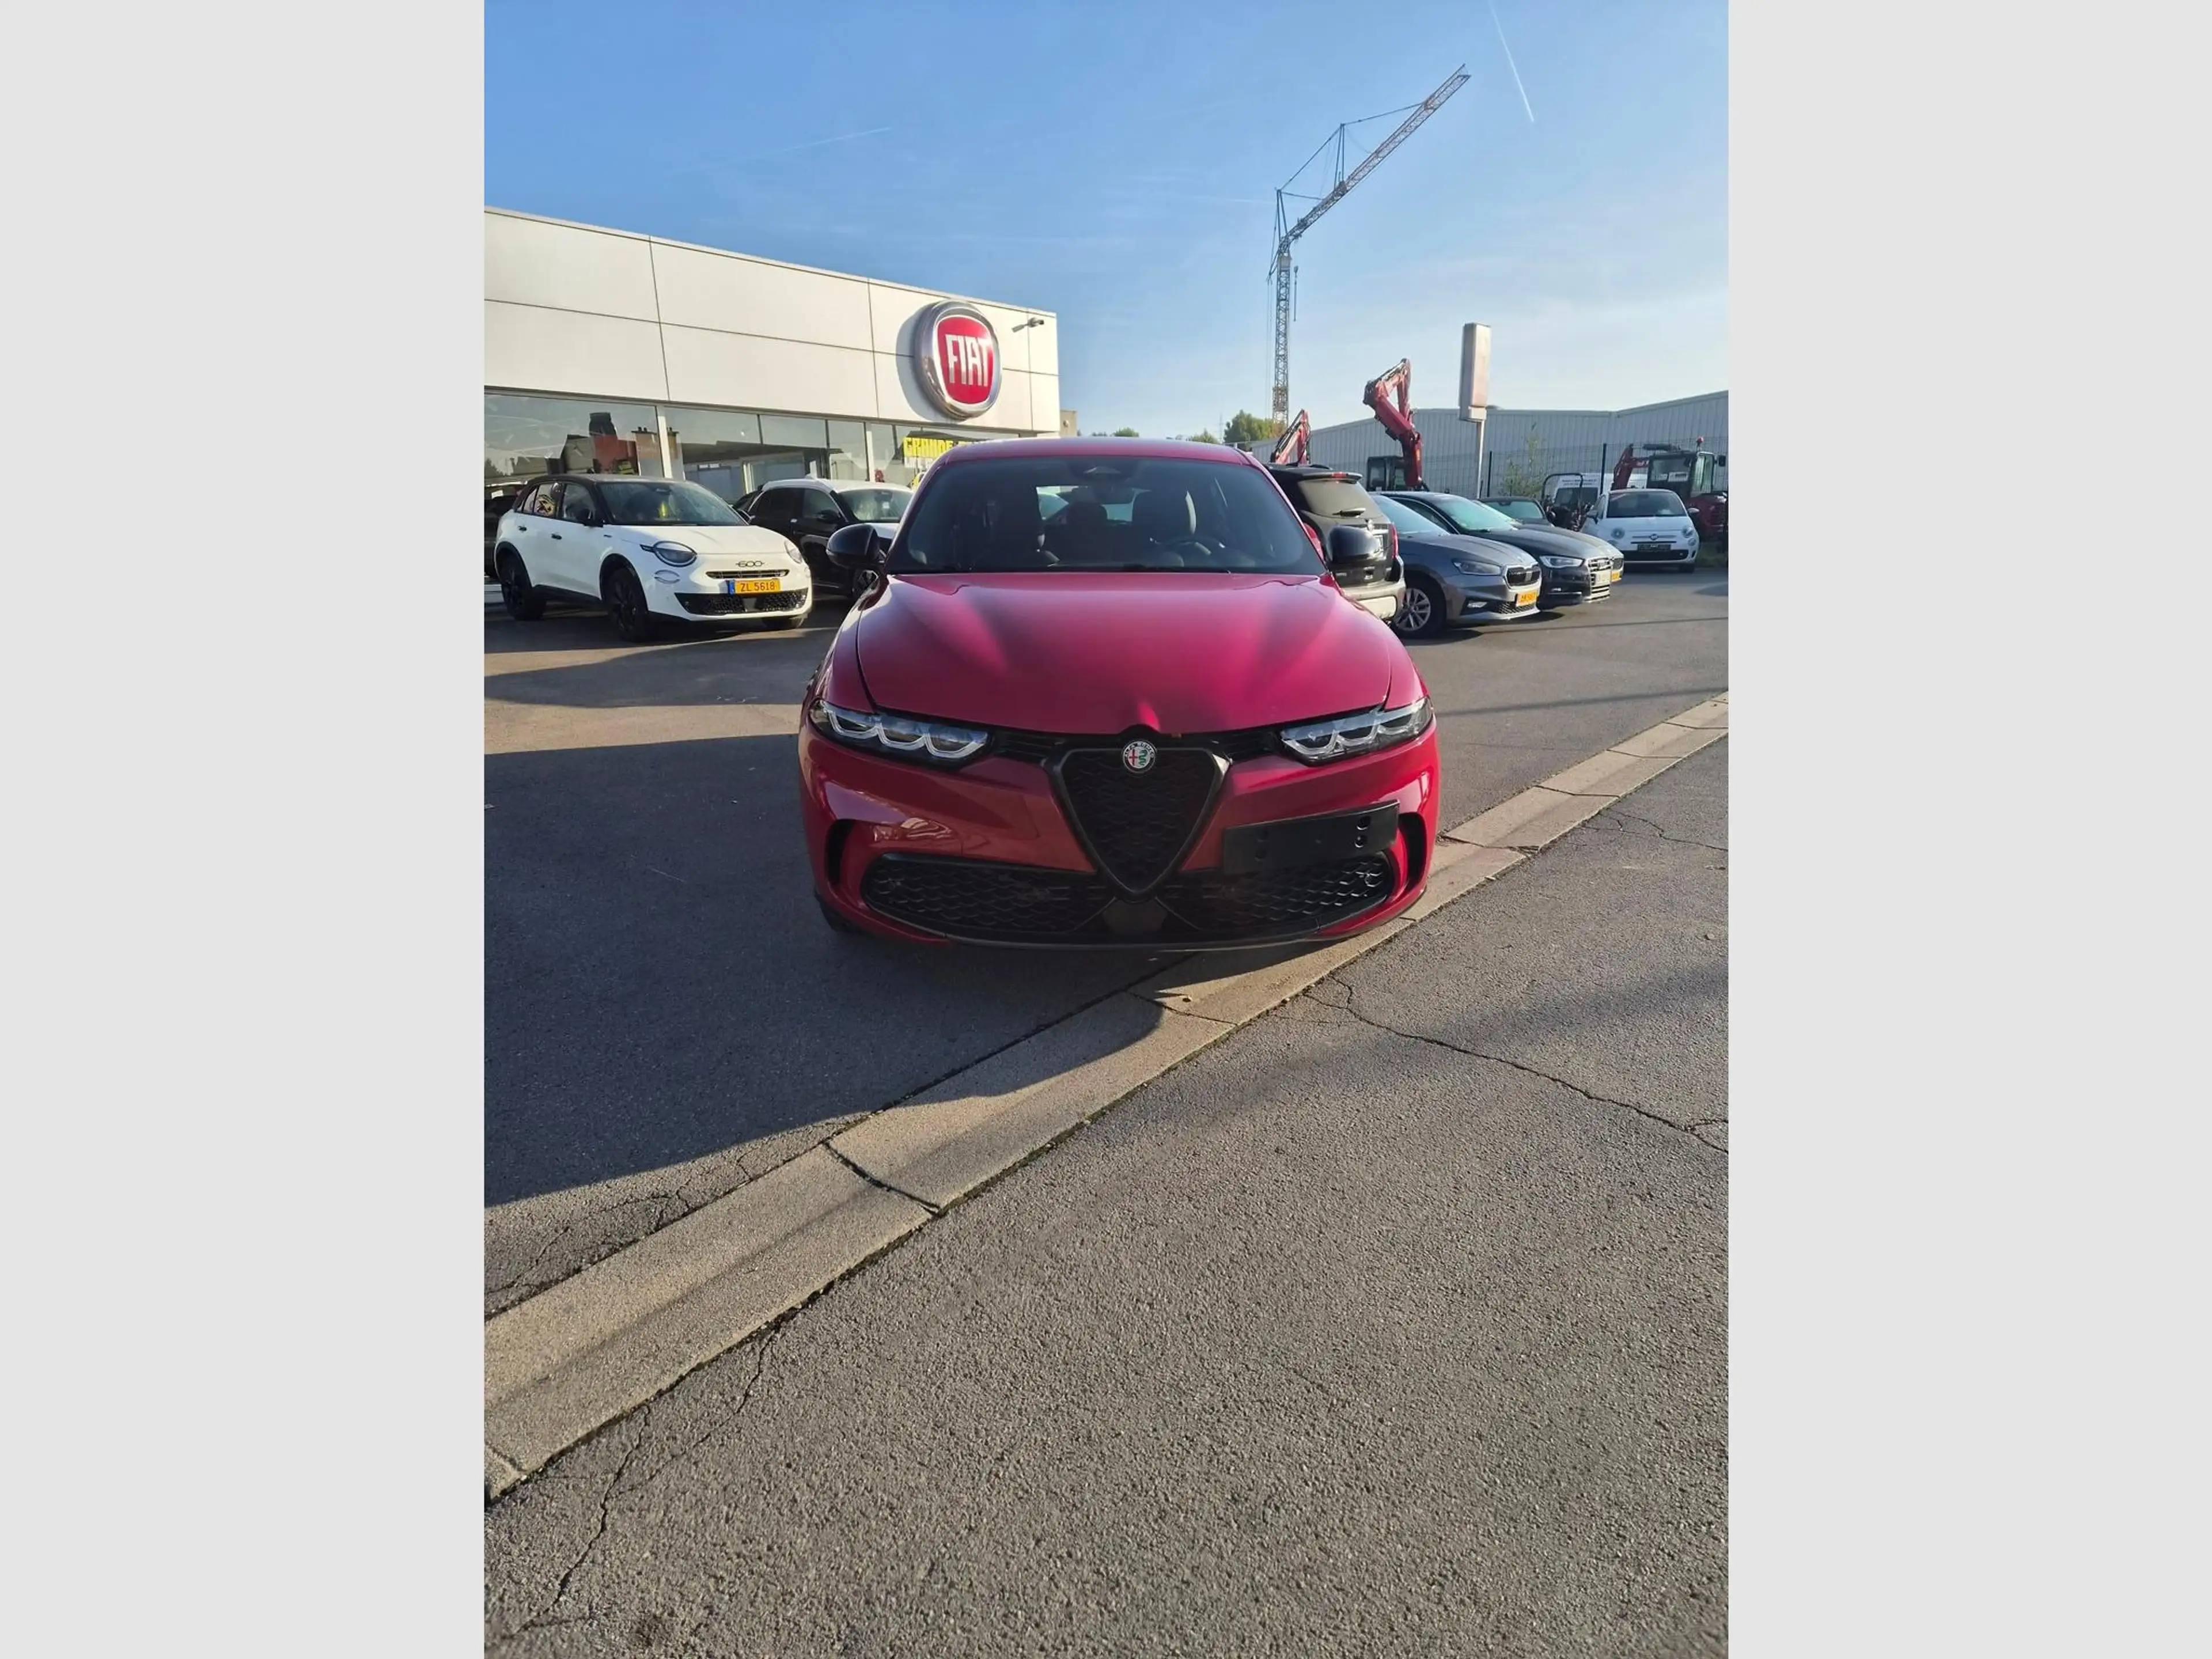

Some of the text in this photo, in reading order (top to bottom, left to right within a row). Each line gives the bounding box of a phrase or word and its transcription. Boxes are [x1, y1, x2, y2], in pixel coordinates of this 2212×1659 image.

[945, 334, 991, 387] FIAT
[903, 437, 953, 458] GRANDE
[740, 582, 775, 592] ZL 5618
